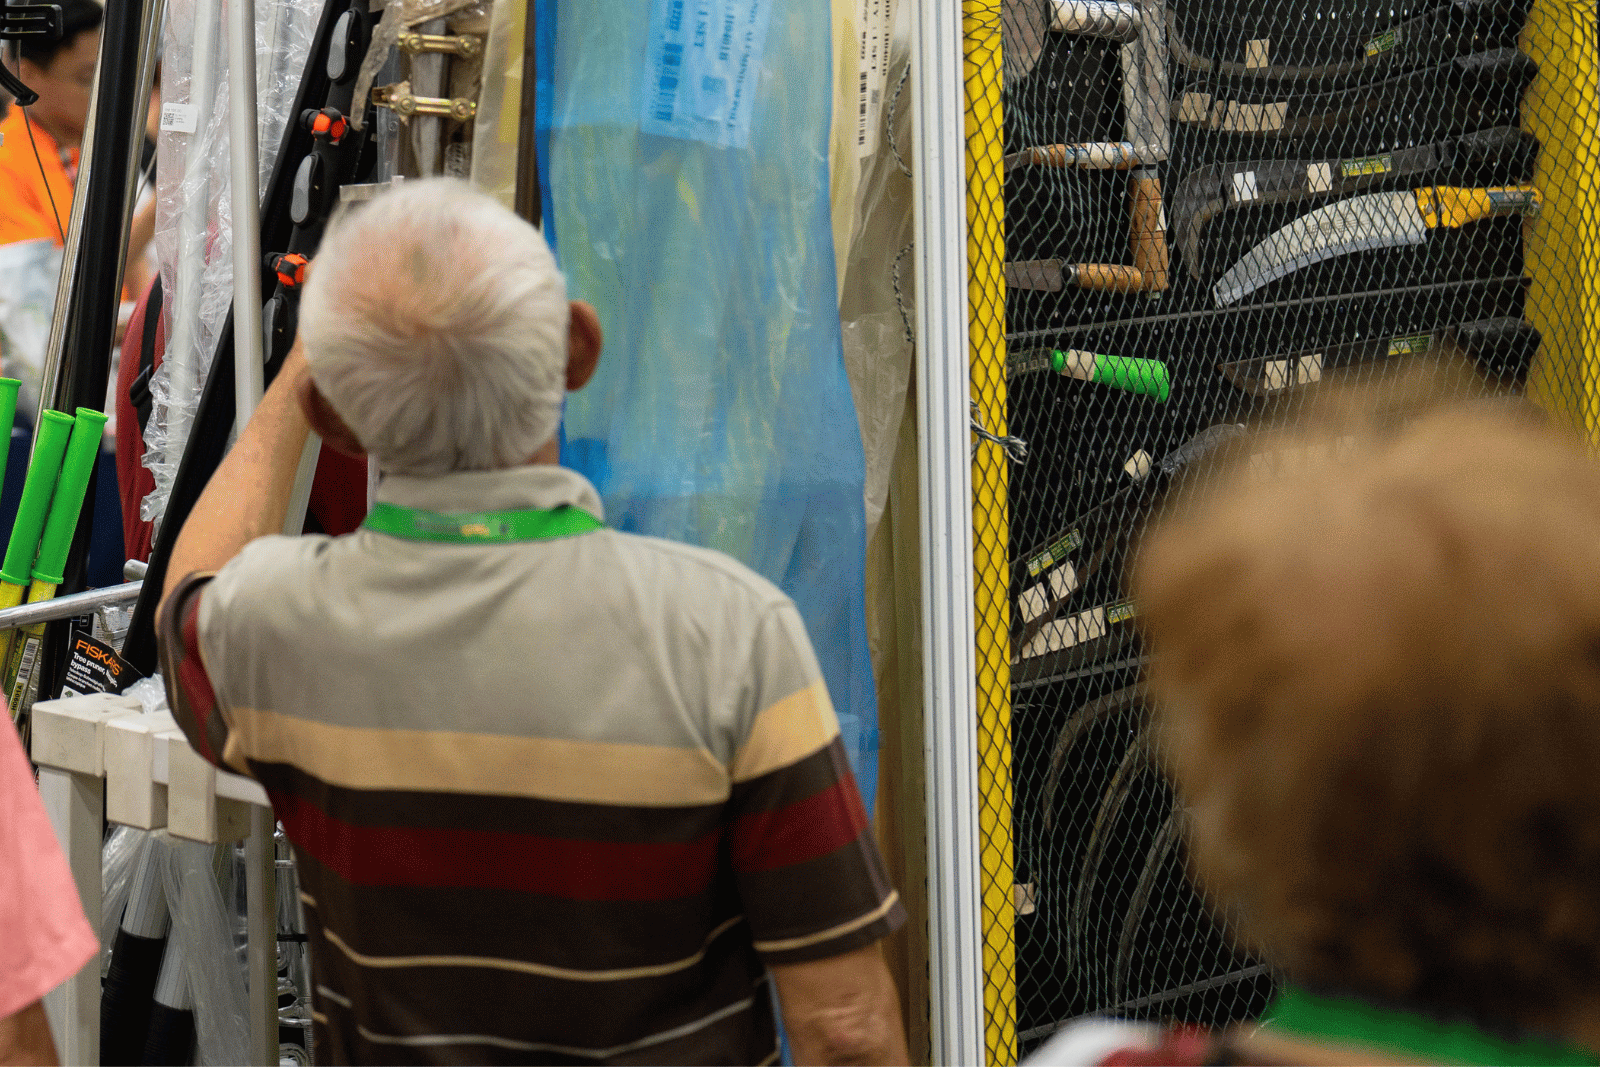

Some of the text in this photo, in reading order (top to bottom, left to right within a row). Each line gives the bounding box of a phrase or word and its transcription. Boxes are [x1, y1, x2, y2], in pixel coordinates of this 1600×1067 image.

[70, 659, 92, 675] bypass
[74, 651, 106, 676] Tree pruner,
